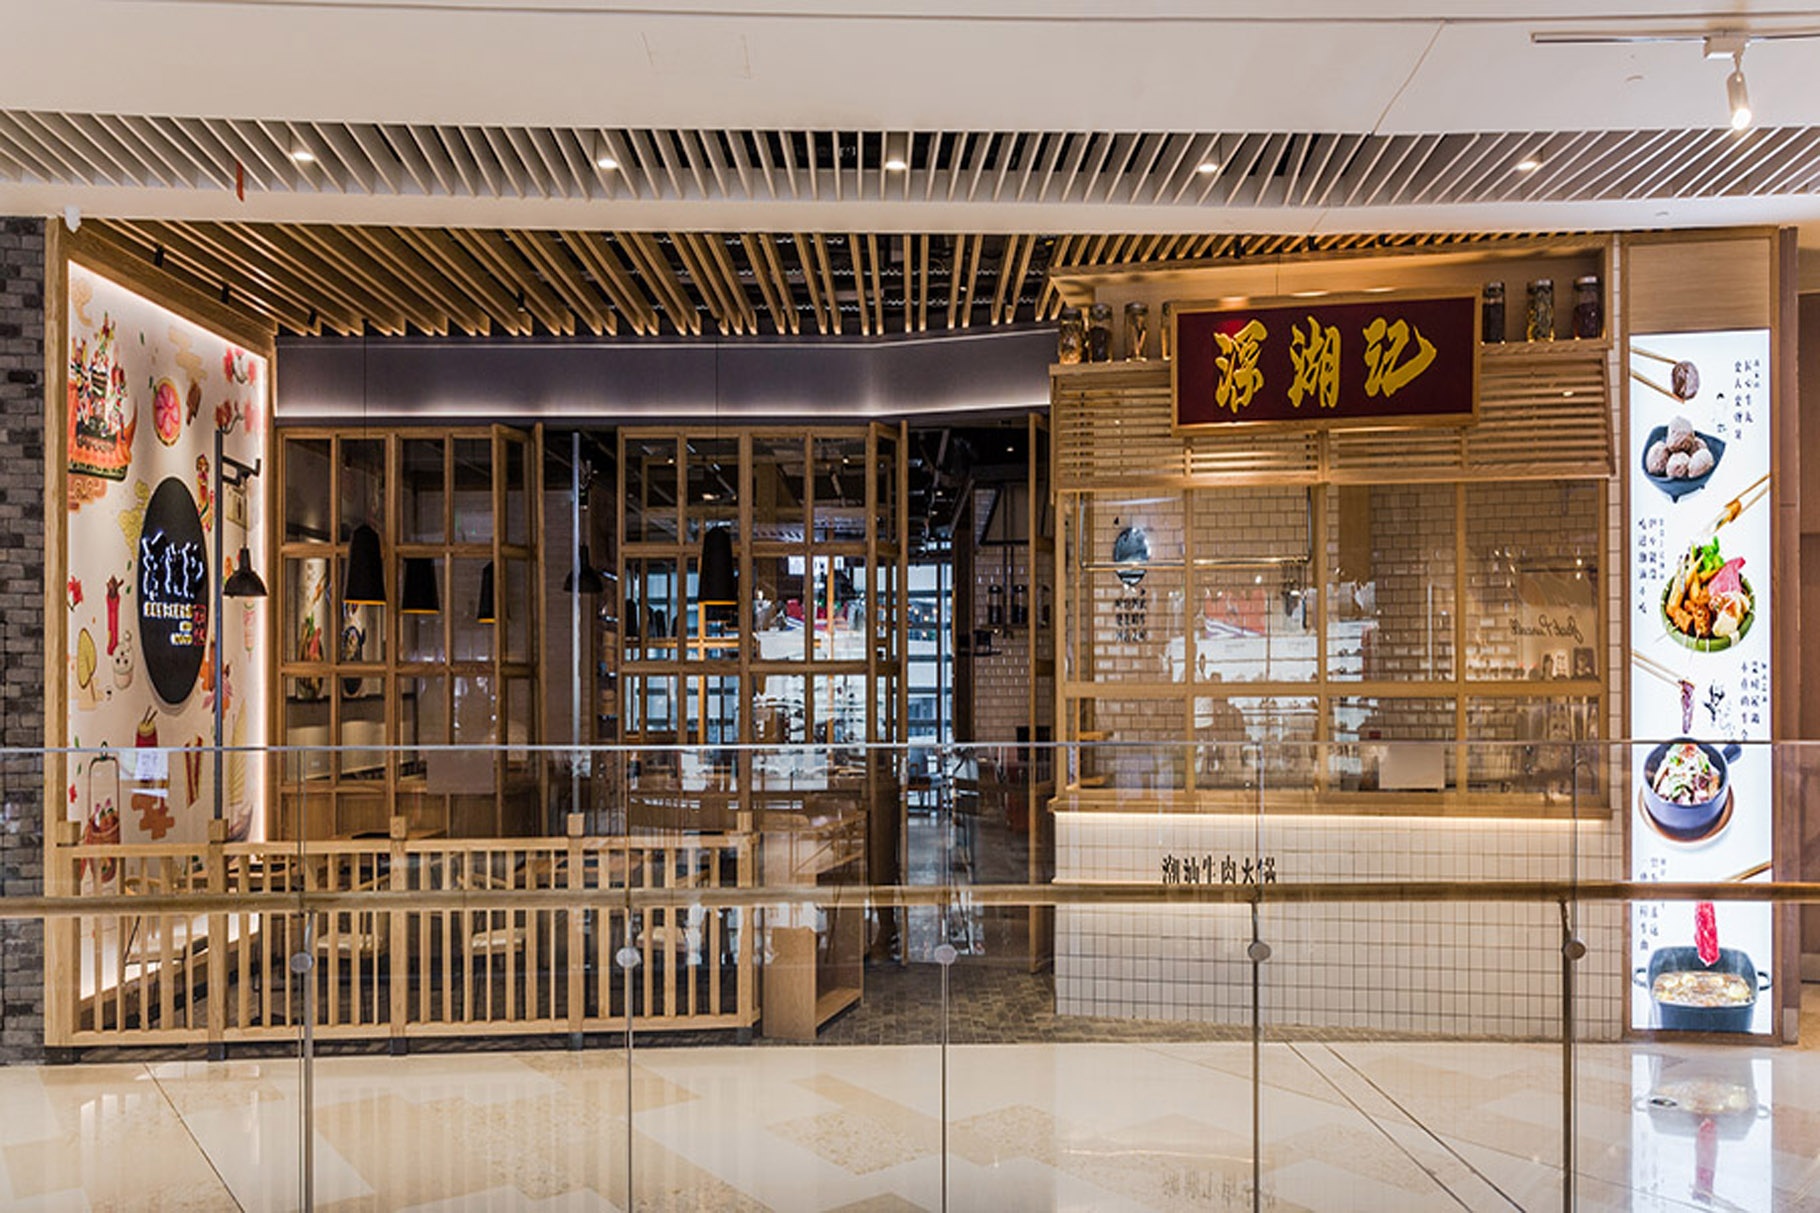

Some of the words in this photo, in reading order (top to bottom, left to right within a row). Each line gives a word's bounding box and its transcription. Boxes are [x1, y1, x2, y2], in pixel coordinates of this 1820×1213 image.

[1162, 854, 1277, 884] 潮汕牛肉火锅
